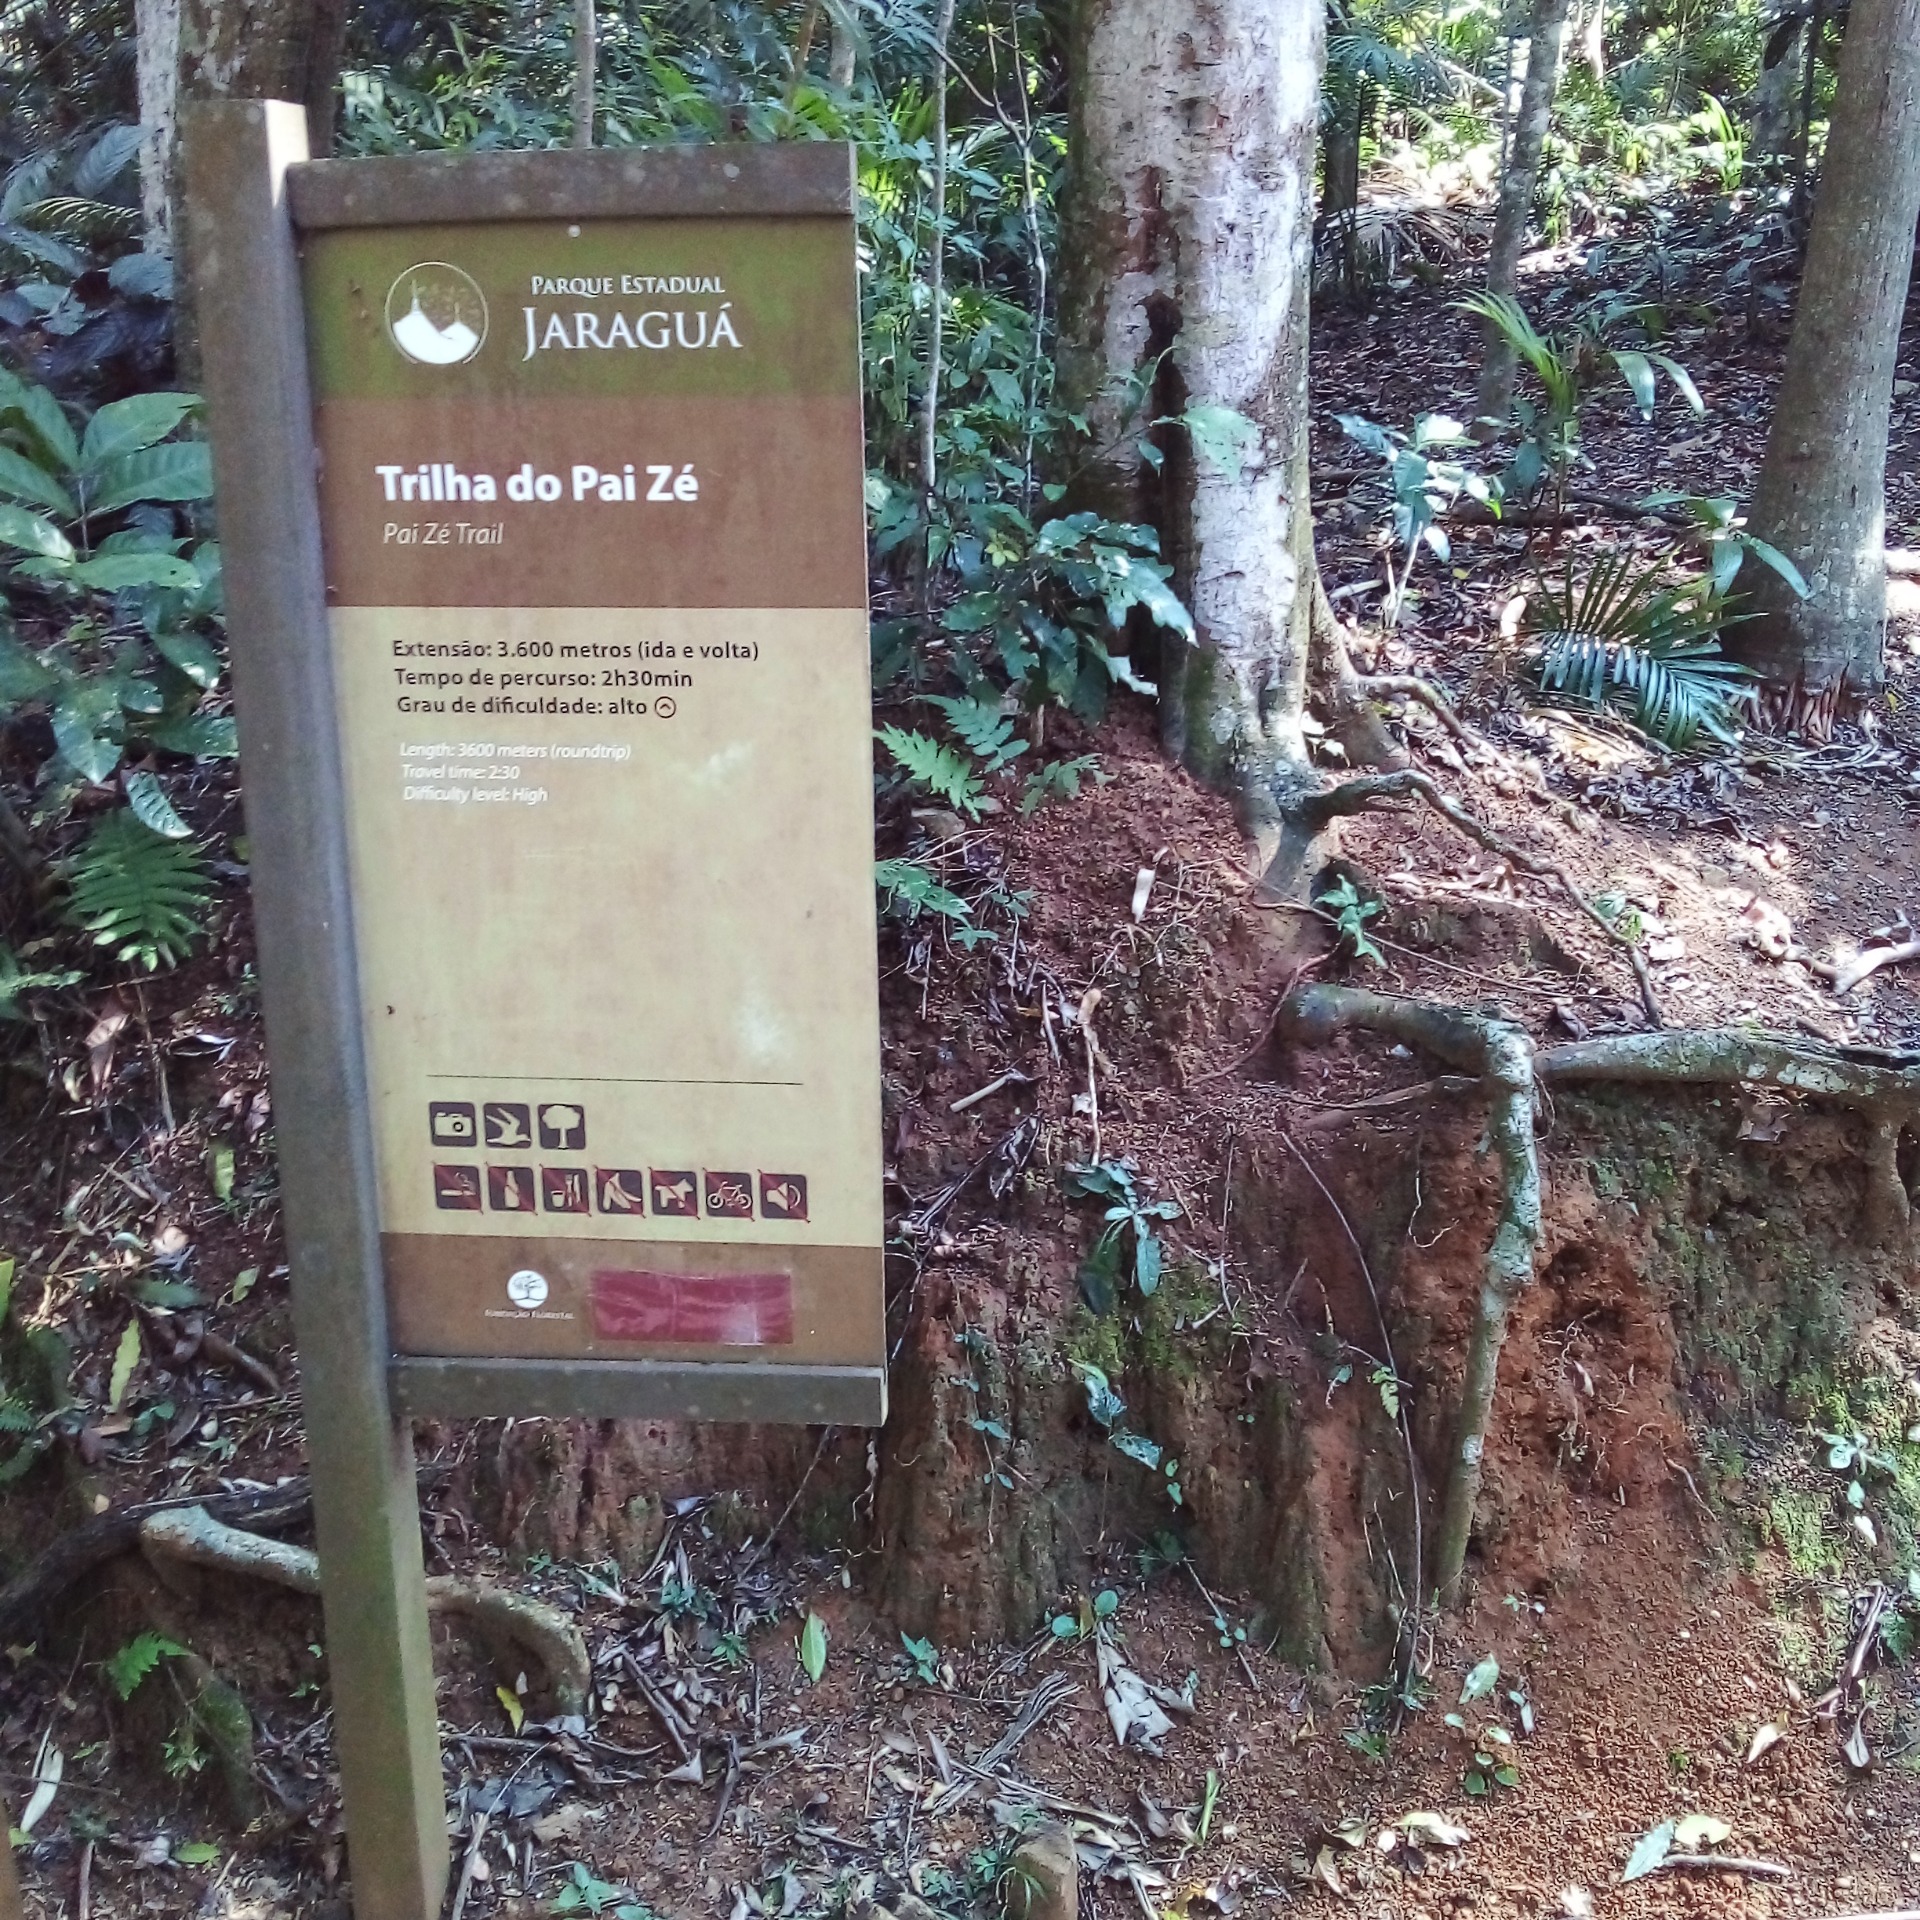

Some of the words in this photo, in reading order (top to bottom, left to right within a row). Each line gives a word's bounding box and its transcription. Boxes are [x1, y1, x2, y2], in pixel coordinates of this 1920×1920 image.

[531, 275, 613, 298] PARQUE
[621, 275, 725, 294] ESTADUAL
[522, 302, 743, 362] JARAGUÁ
[375, 464, 497, 501] Trilha
[506, 464, 562, 501] do
[571, 465, 636, 501] Pai
[646, 464, 699, 501] Zé
[383, 523, 418, 544] Pai
[422, 523, 450, 544] Zé
[456, 522, 504, 544] Trail
[393, 640, 491, 658] Extensão:
[497, 641, 553, 658] 3.600
[560, 643, 632, 659] metros
[637, 640, 676, 661] (ida
[683, 646, 694, 659] e
[700, 640, 760, 661] volta)
[395, 669, 463, 689] Tempo
[469, 669, 494, 686] de
[501, 673, 596, 689] percurso:
[601, 669, 692, 688] 2h30min
[397, 697, 445, 714] Grau
[451, 696, 476, 714] de
[482, 696, 602, 715] dificuldade:
[608, 697, 647, 715] alto
[400, 742, 454, 760] Length:
[458, 743, 492, 758] 3600
[497, 744, 548, 759] meters
[403, 764, 446, 780] Travel
[449, 765, 485, 780] time:
[488, 766, 520, 780] 2:30
[404, 786, 471, 805] Difficulty
[473, 787, 510, 803] level:
[513, 788, 548, 806] High
